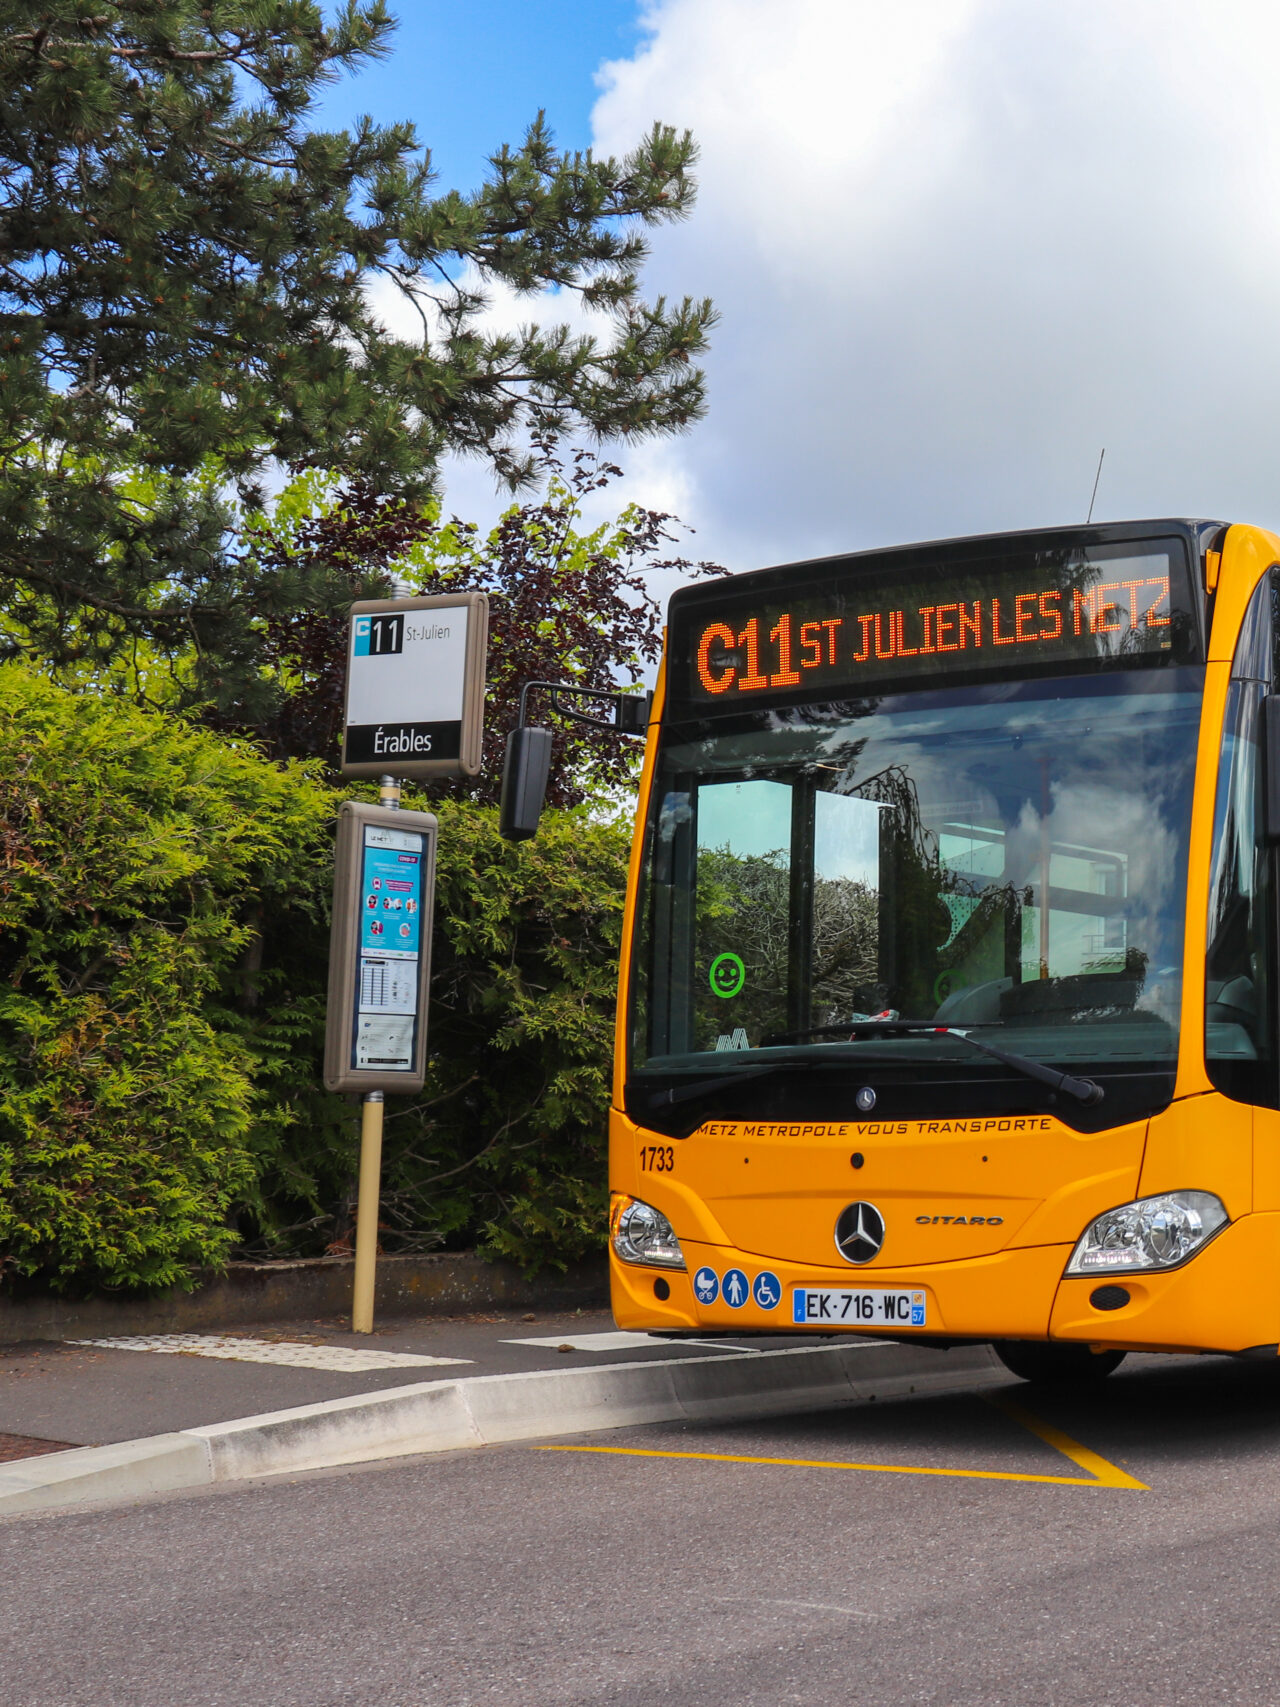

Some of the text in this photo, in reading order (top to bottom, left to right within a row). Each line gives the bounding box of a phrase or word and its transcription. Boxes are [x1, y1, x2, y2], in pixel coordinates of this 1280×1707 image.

[406, 624, 450, 641] St-Julien
[697, 575, 1171, 694] C11 ST JULIEN LES METZ
[374, 726, 432, 754] Érables
[695, 1118, 1051, 1136] METZ METROPOLE VOUS TRANSPORTE
[639, 1146, 674, 1172] 1733
[915, 1215, 1004, 1226] CITARO
[912, 1310, 923, 1322] 57
